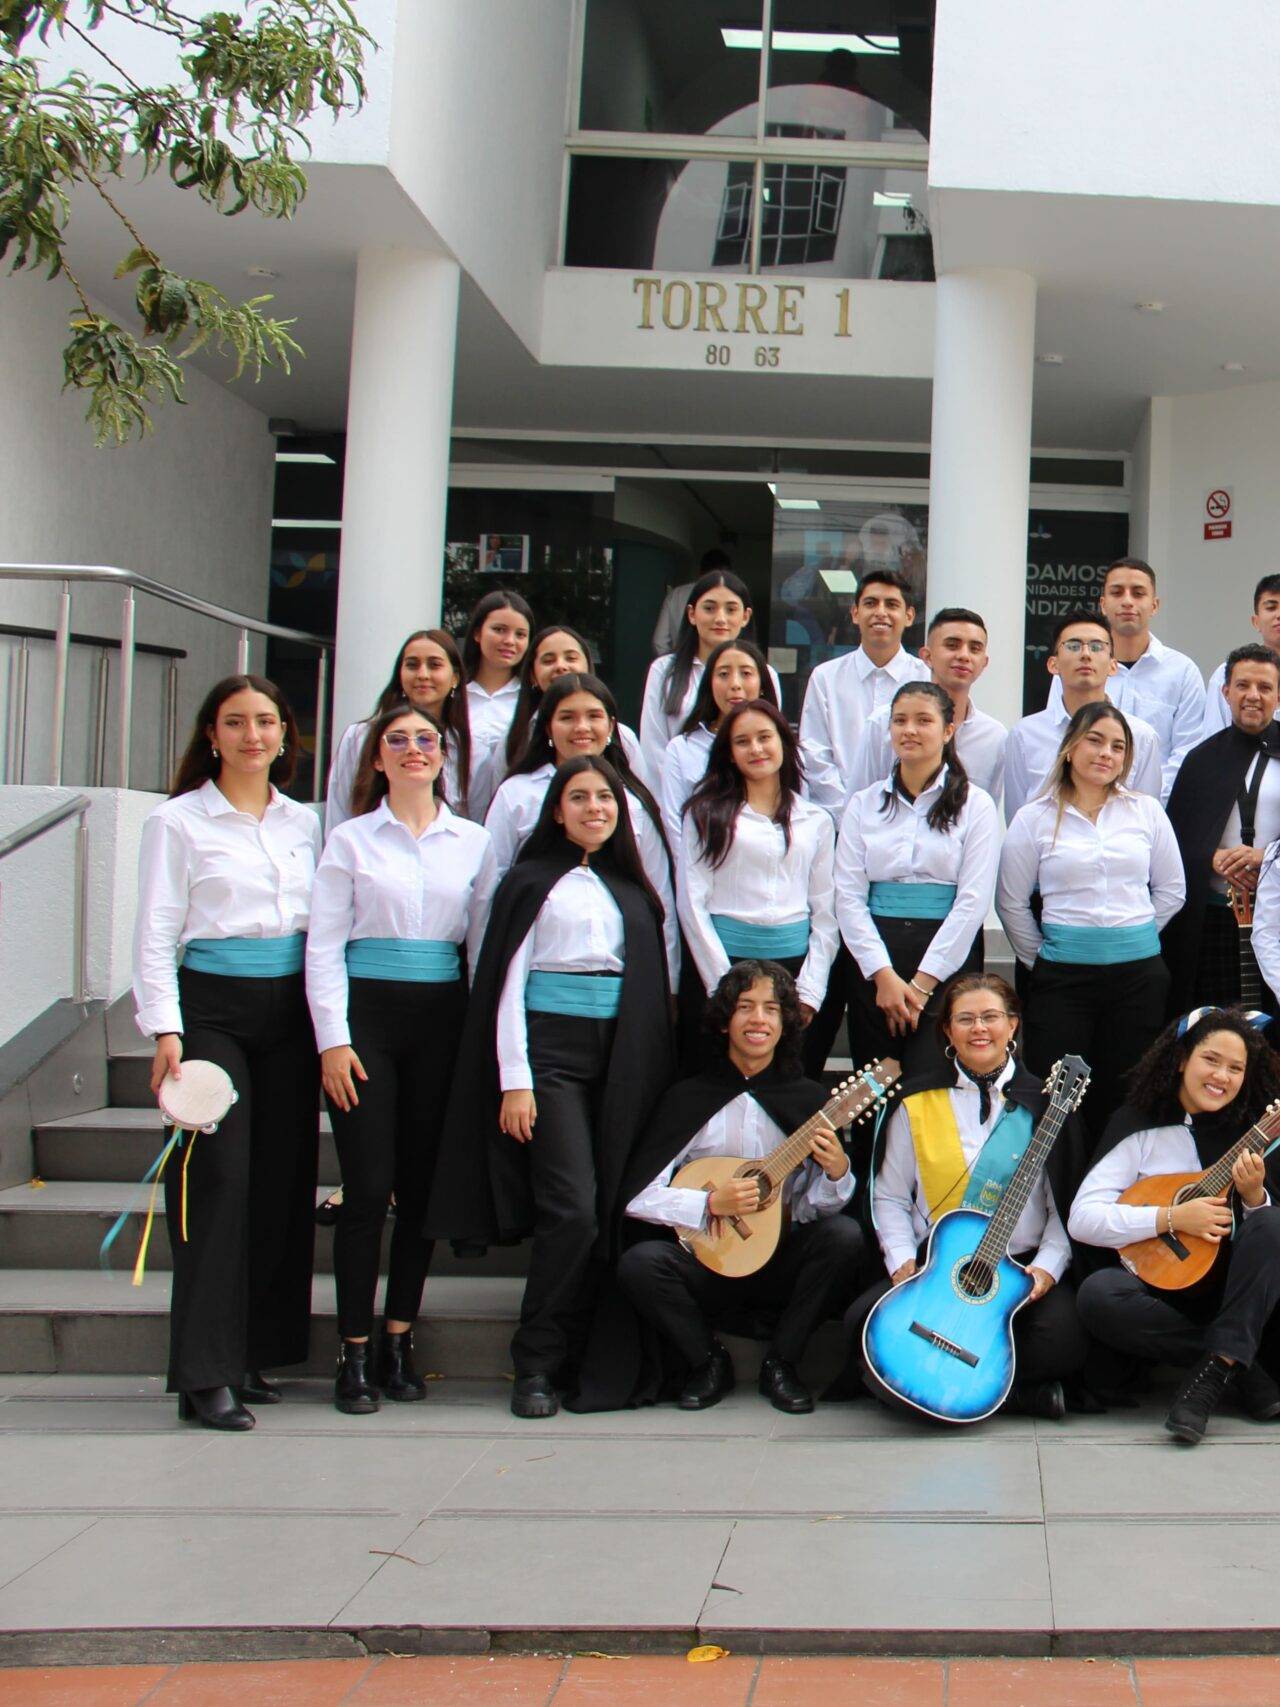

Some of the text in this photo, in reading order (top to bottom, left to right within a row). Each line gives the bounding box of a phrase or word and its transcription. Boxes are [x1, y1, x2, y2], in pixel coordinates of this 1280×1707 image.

[633, 278, 853, 337] TORRE 1
[705, 344, 781, 368] 80 63
